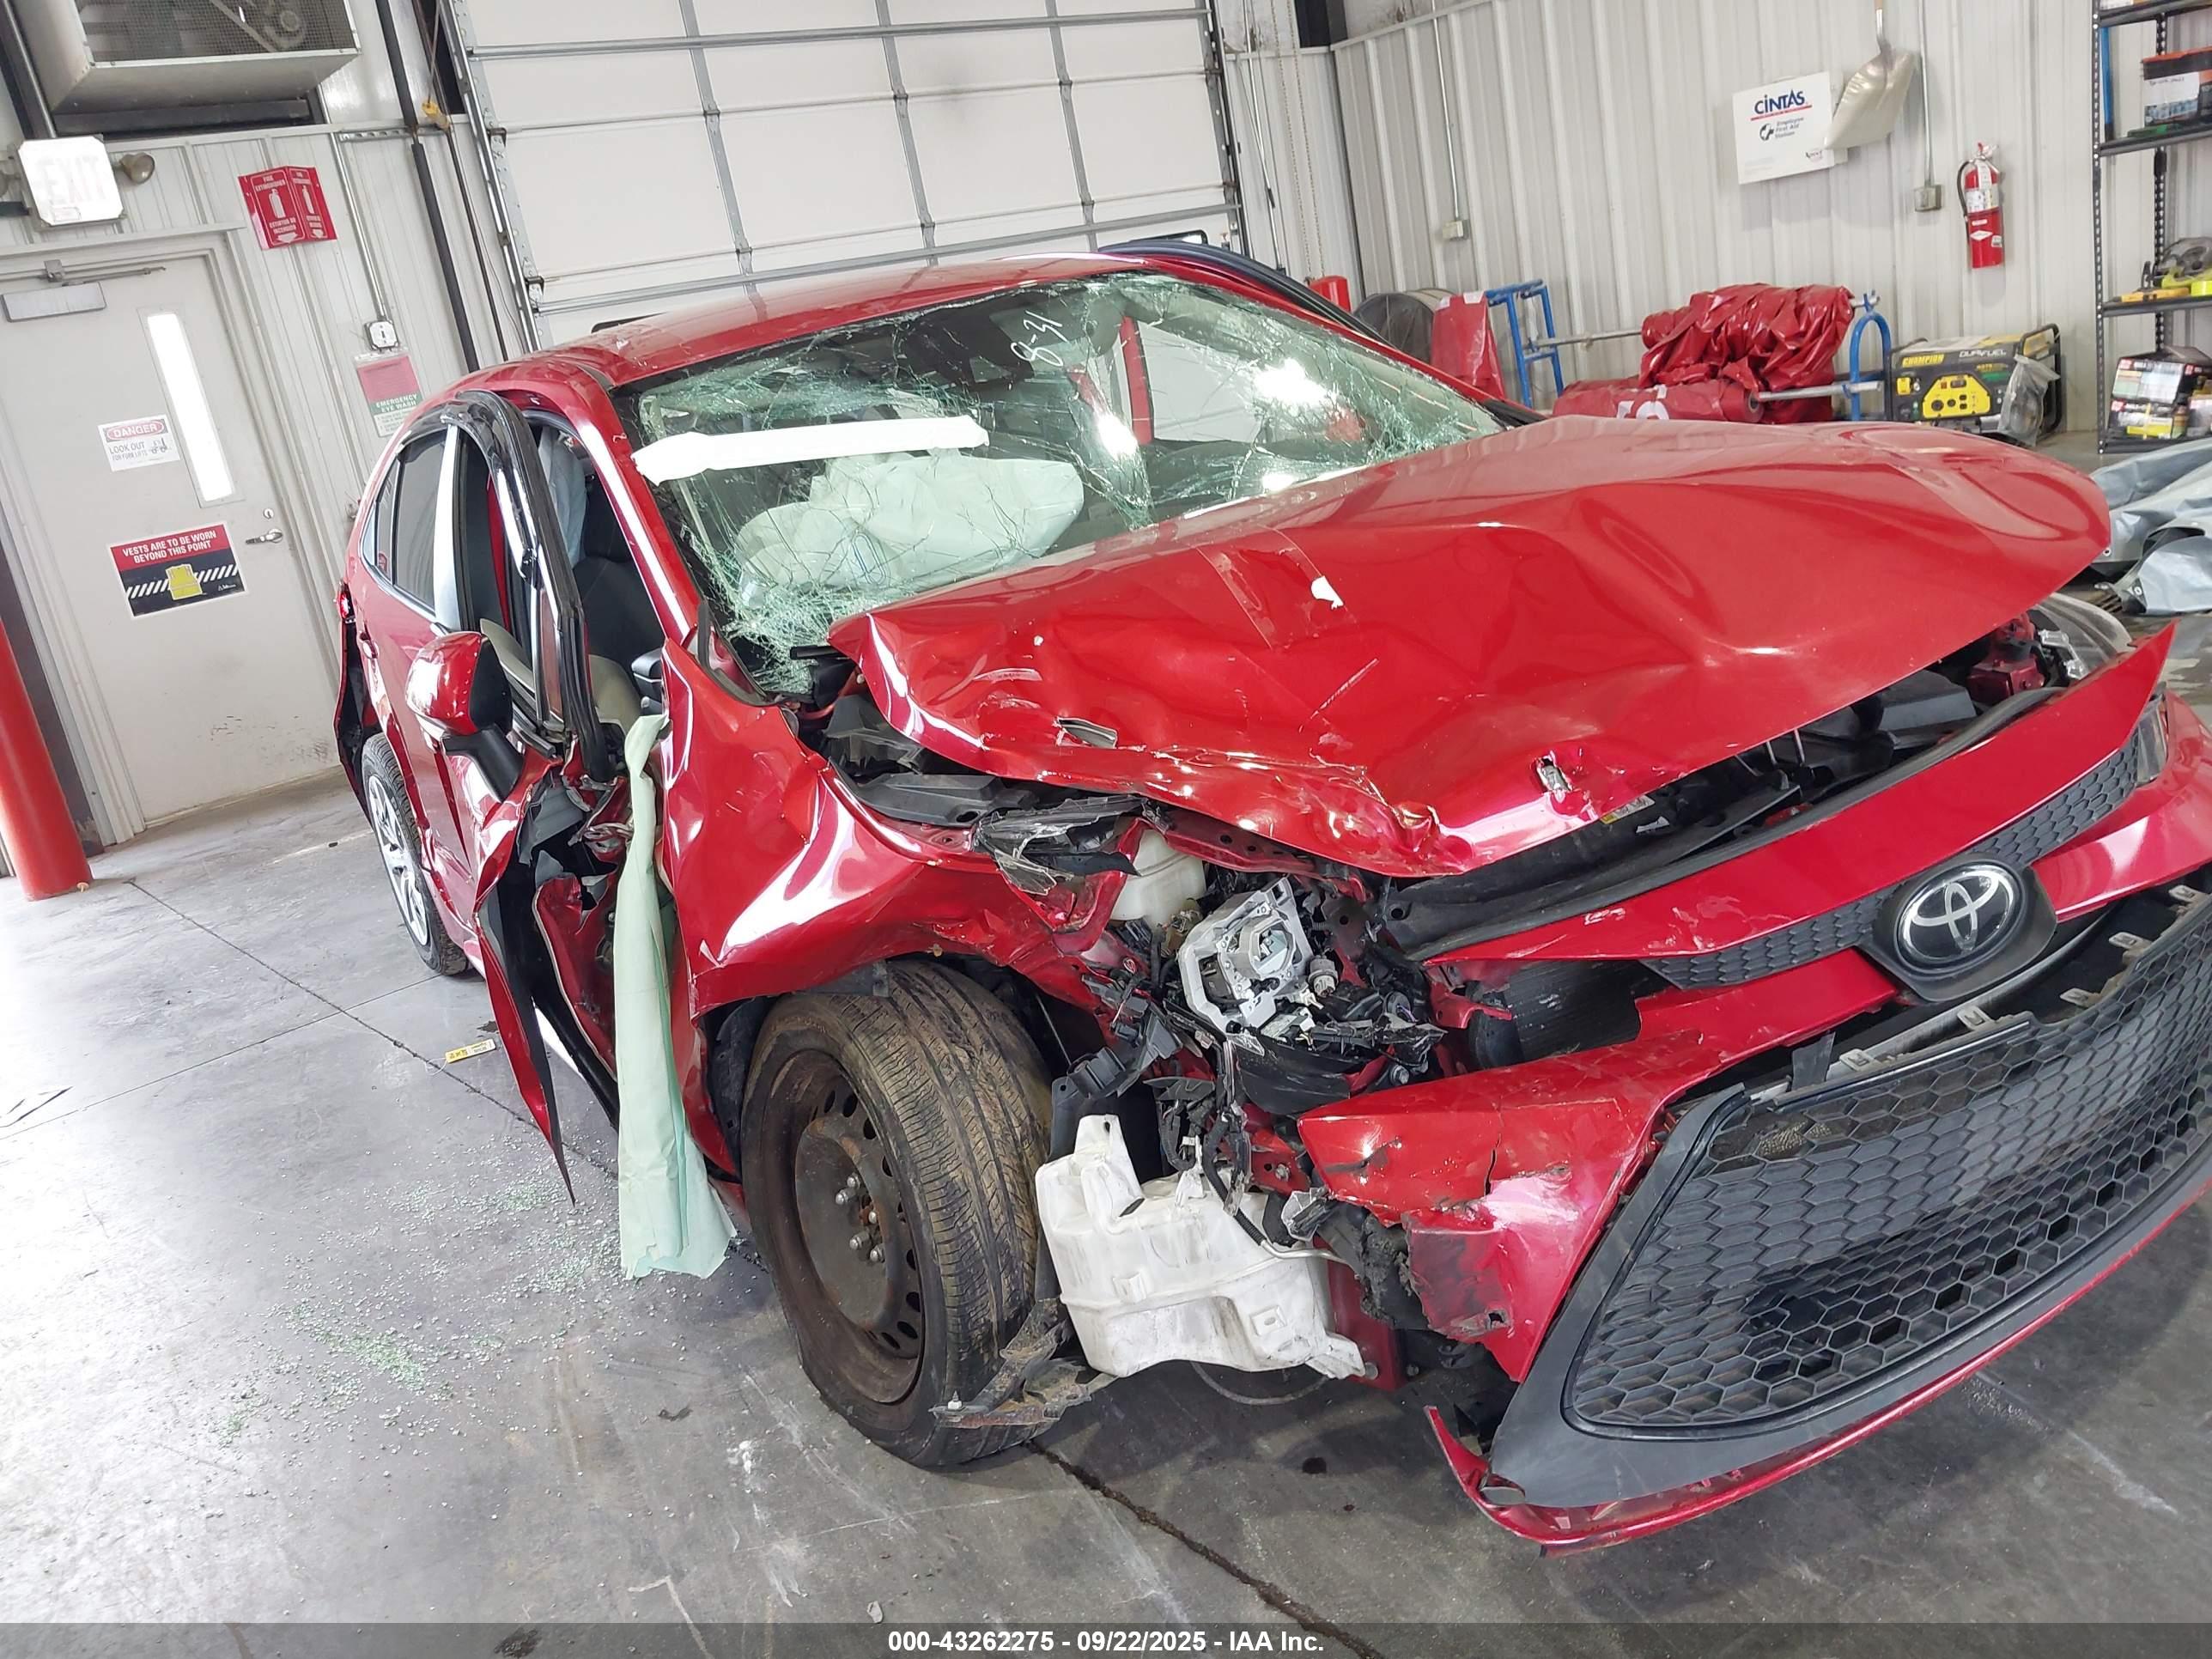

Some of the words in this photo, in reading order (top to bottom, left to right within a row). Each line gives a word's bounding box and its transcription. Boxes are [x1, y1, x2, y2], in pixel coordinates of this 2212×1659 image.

[1902, 354, 1945, 368] CHAMPION
[376, 393, 417, 408] EMERGENCY
[381, 404, 395, 413] EYE
[396, 401, 416, 410] WASH
[113, 423, 158, 438] DANGER
[109, 443, 131, 454] LOOK
[131, 441, 145, 451] OUT
[123, 544, 149, 556] VESTS
[150, 540, 167, 553] ARE
[167, 538, 179, 548] TO
[179, 535, 191, 545] BE
[191, 530, 217, 543] WORN
[133, 550, 167, 564] BEYOND
[167, 545, 187, 556] THIS
[188, 541, 212, 552] POINT
